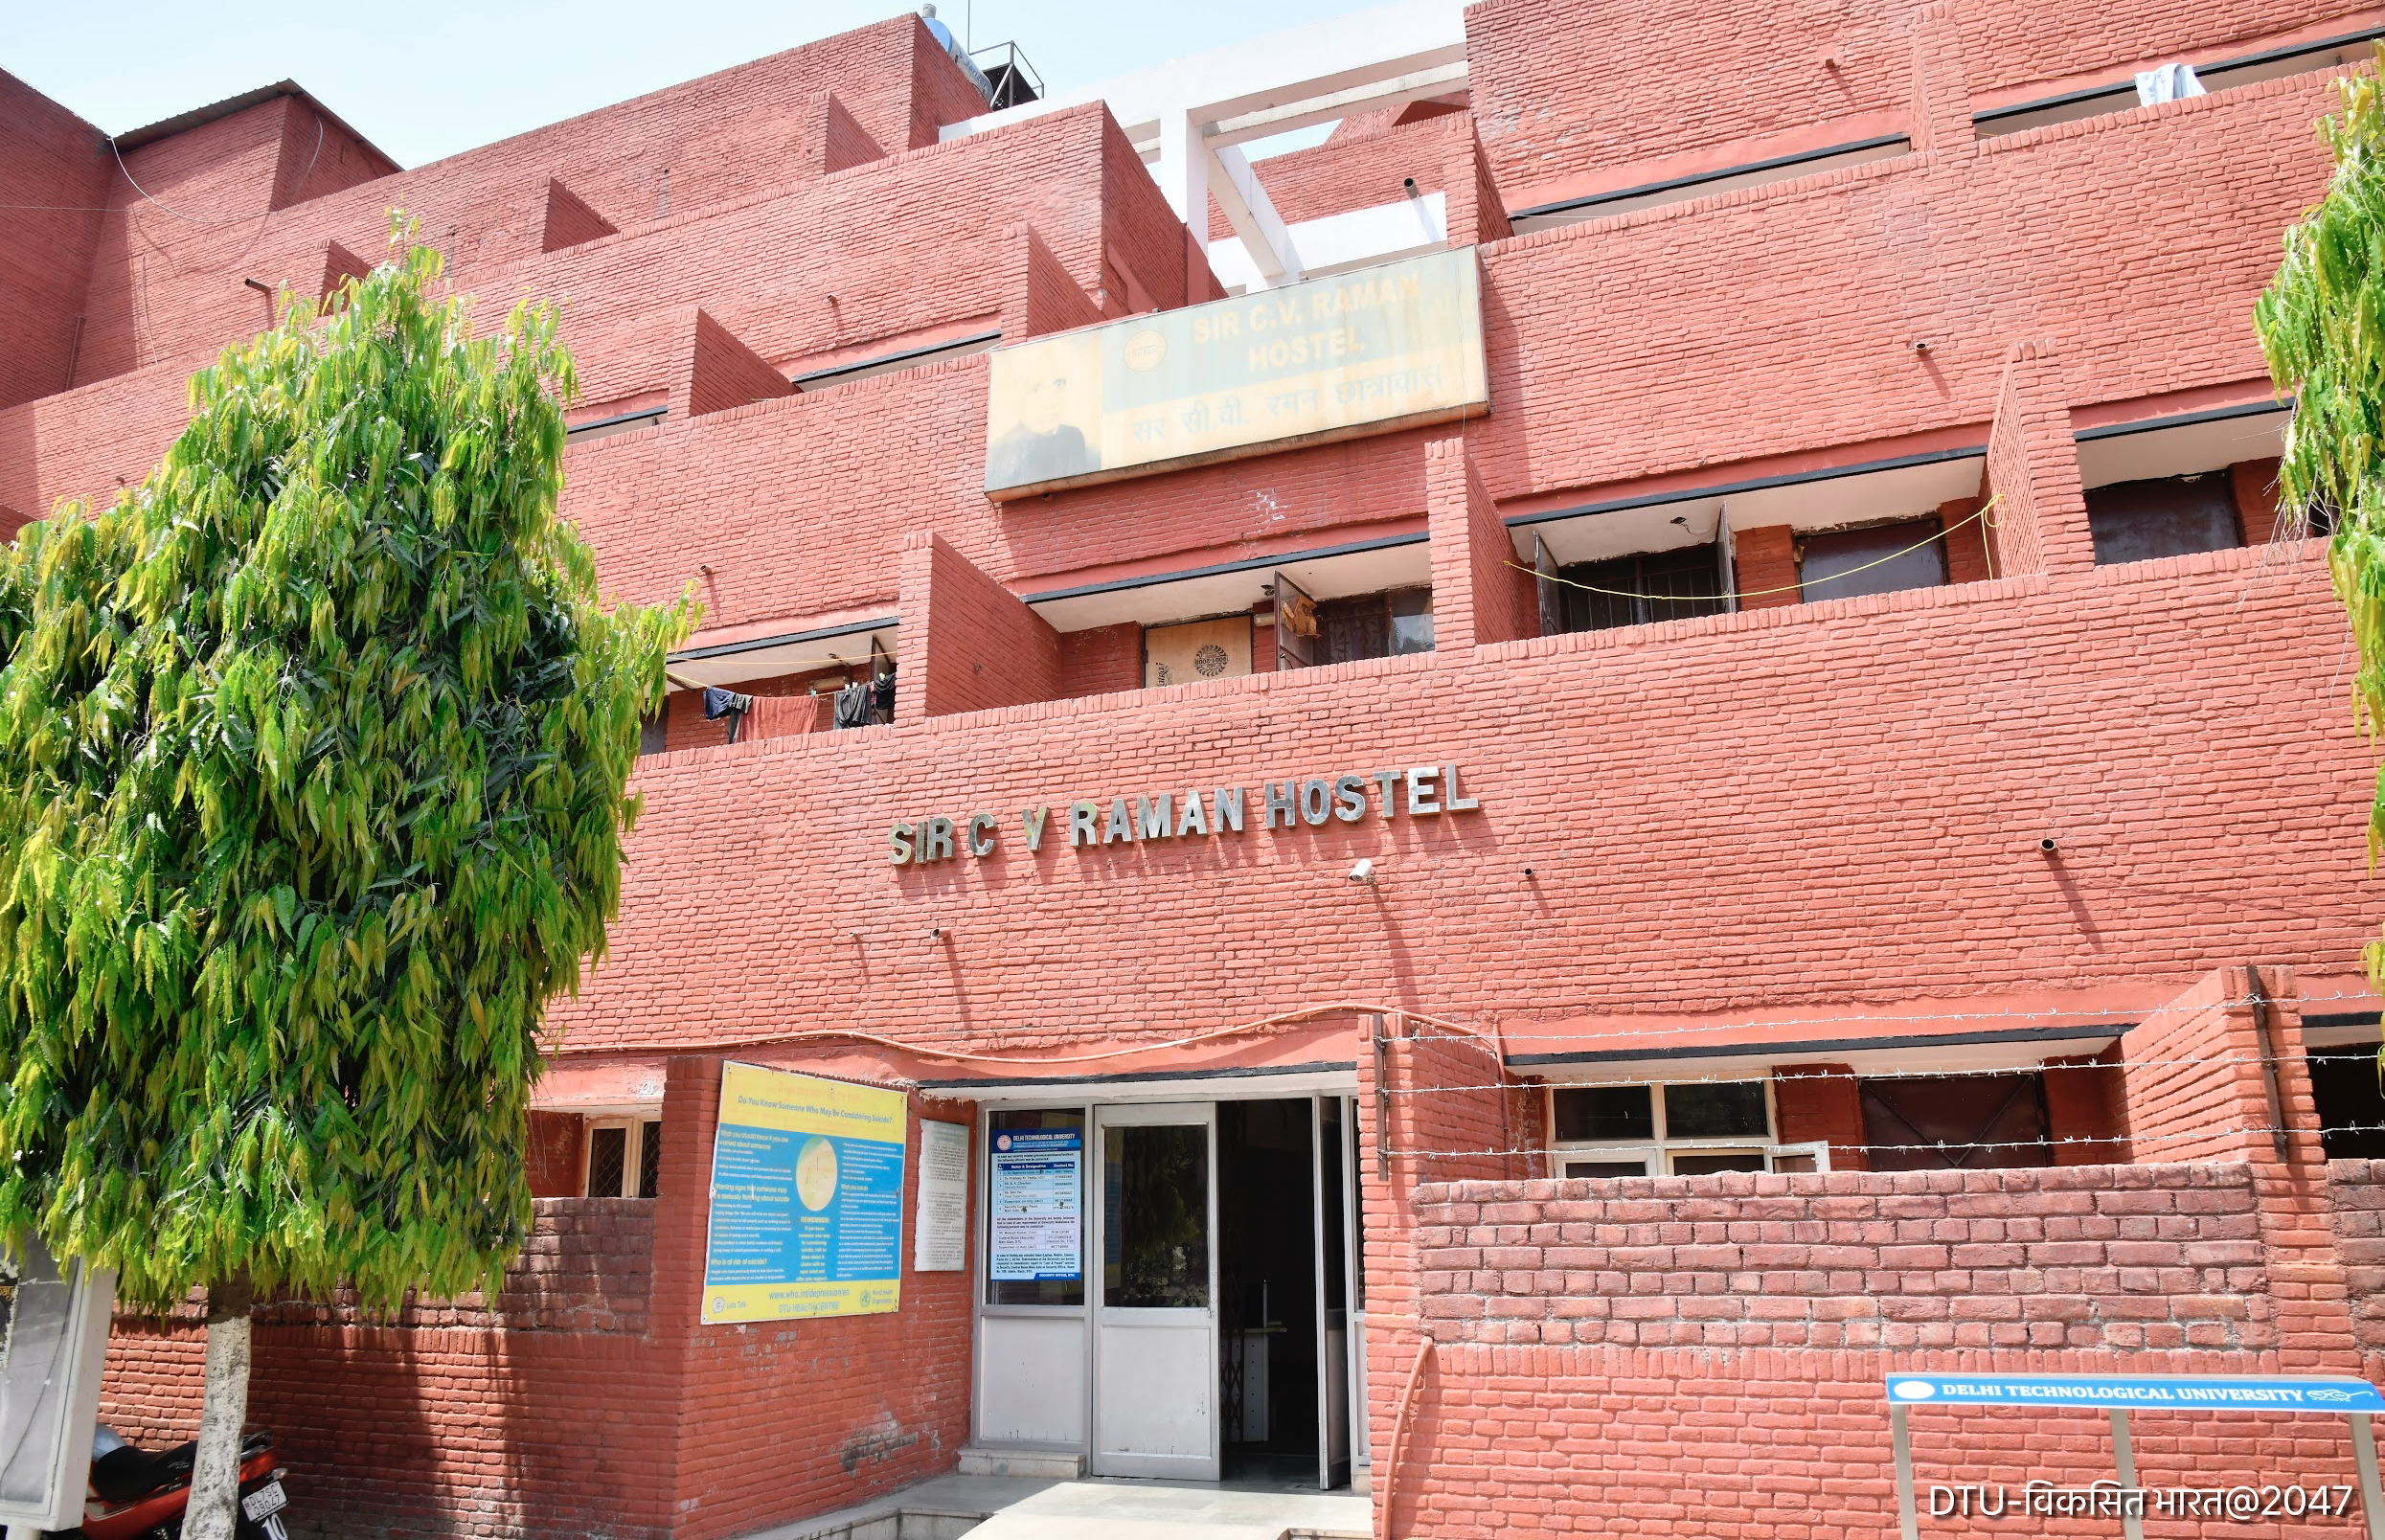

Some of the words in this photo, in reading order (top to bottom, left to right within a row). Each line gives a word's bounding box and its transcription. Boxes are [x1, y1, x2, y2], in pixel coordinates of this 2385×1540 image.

[1193, 312, 1239, 344] SIR
[1250, 300, 1301, 332] C.V.
[1313, 273, 1420, 318] RAMAN
[1248, 328, 1365, 372] HOSTEL
[1132, 417, 1166, 443] सर
[1266, 386, 1318, 417] रमन
[887, 814, 954, 866] SIR
[968, 813, 997, 858] C
[1021, 806, 1051, 852] V
[1069, 787, 1244, 849] RAMAN
[1264, 764, 1478, 831] HOSTEL
[738, 1095, 747, 1104] Do
[748, 1097, 760, 1106] You
[760, 1098, 778, 1109] Know
[778, 1100, 806, 1112] Someone
[806, 1105, 819, 1115] Who
[820, 1107, 832, 1118] May
[832, 1108, 840, 1117] Be
[840, 1110, 872, 1122] Considering
[779, 1303, 792, 1313] DTU
[816, 1301, 839, 1311] CENTRE
[1942, 1384, 2002, 1397] DELHI
[2006, 1385, 2174, 1400] TECHNOLOGICAL
[2177, 1388, 2304, 1403] UNIVERSITY
